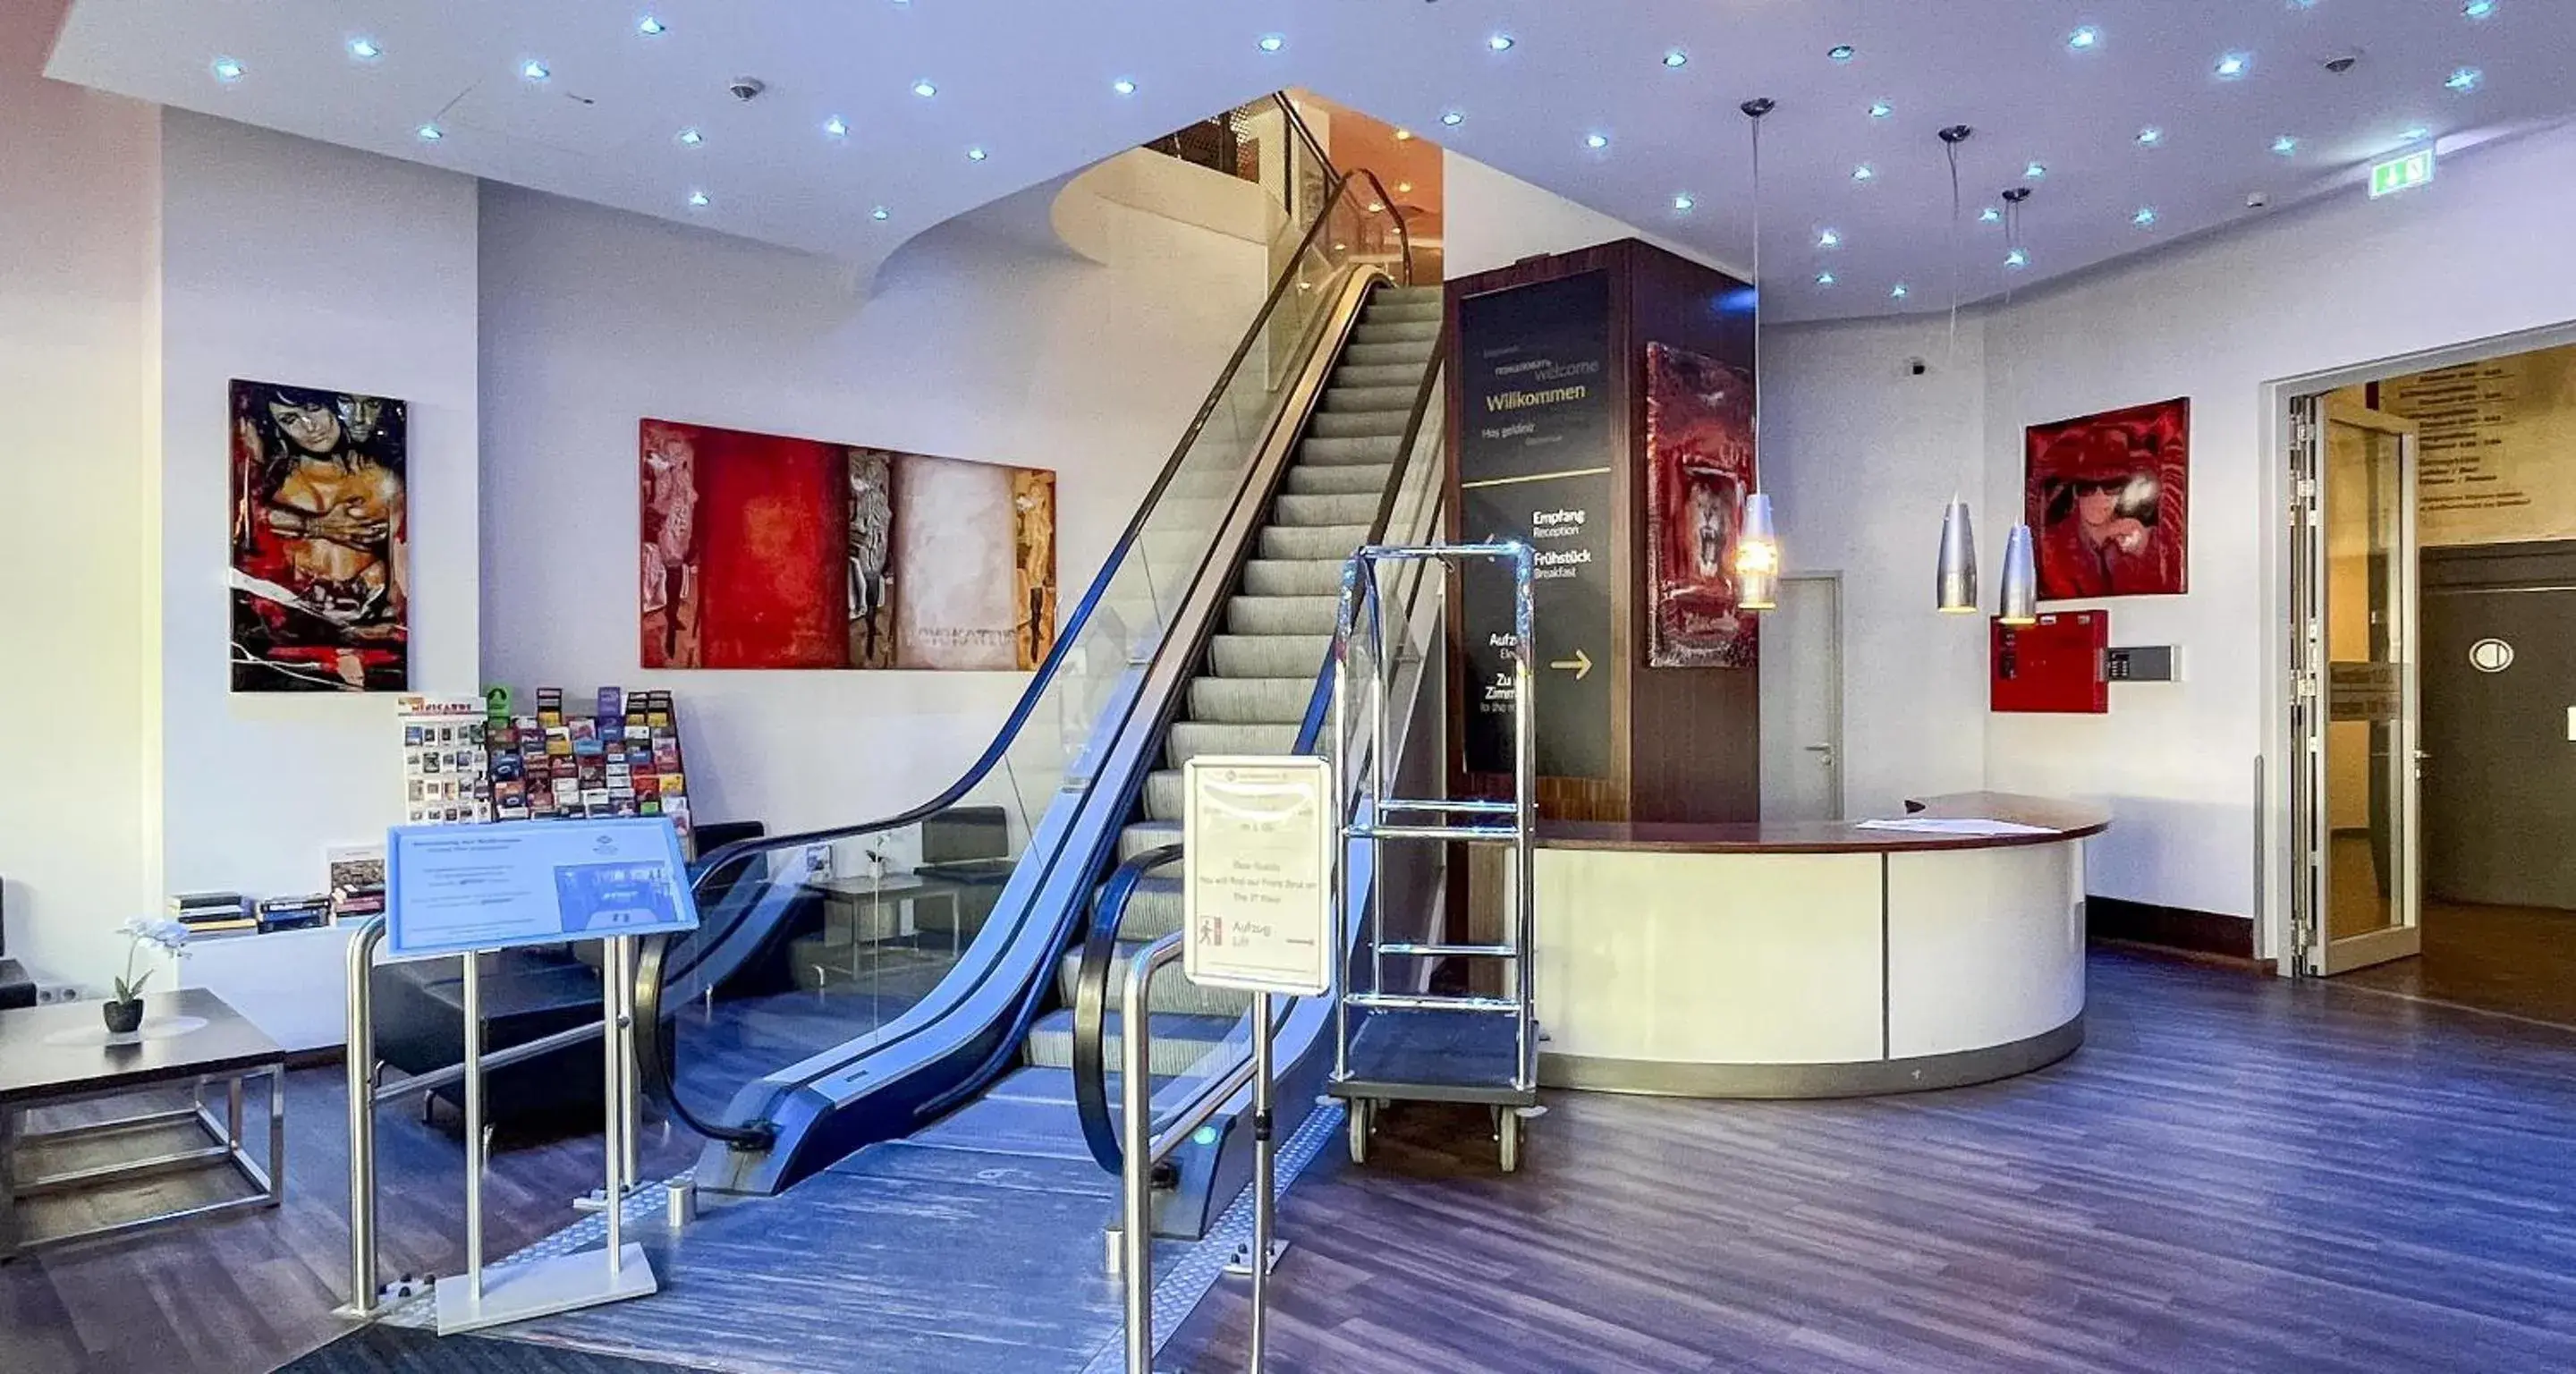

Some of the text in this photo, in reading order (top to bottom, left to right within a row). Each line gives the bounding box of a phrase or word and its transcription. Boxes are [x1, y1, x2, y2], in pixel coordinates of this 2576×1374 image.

[1535, 360, 1599, 381] welcome
[1486, 385, 1586, 411] Willkommen
[1533, 509, 1586, 525] Empfang
[1533, 526, 1580, 538] Reception
[1534, 549, 1592, 566] Frühstück
[1534, 566, 1577, 580] Breakfast
[1489, 632, 1517, 646] Aufz
[1496, 673, 1513, 686] Zu
[1233, 921, 1272, 937] Aufzug
